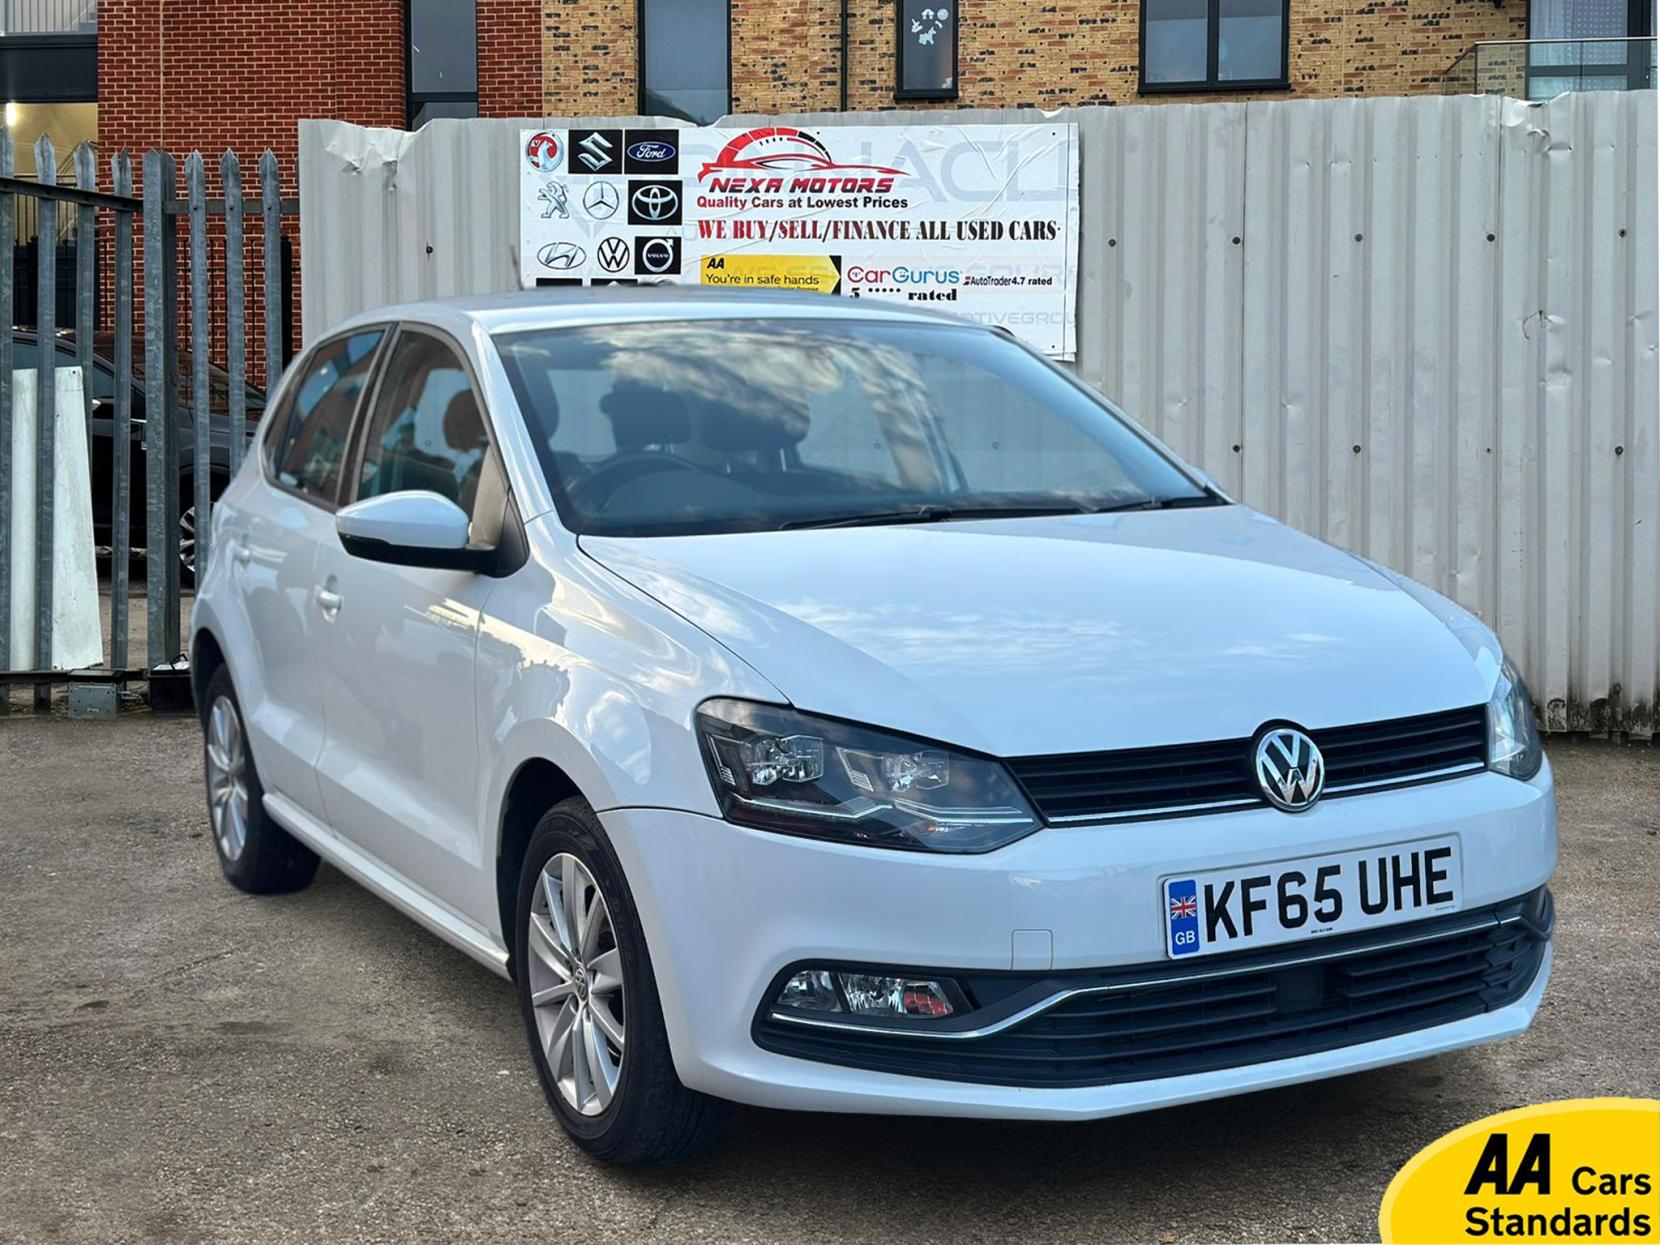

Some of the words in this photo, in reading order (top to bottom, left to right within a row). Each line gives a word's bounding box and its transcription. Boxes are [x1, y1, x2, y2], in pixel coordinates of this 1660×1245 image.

[637, 144, 666, 158] Ford
[709, 178, 783, 193] NEXA
[789, 178, 894, 193] MOTORS
[697, 196, 747, 210] Quality
[752, 196, 784, 208] Cars
[788, 197, 801, 208] at
[807, 196, 858, 208] Lowest
[863, 196, 908, 208] Prices
[697, 220, 727, 240] WE
[916, 220, 951, 240] ALL
[956, 220, 1003, 240] USED
[1009, 220, 1057, 240] CARS
[706, 257, 725, 269] AA
[706, 273, 741, 284] You're
[744, 273, 755, 284] in
[757, 273, 781, 285] safe
[783, 274, 820, 286] hands
[847, 266, 960, 284] CarGurus
[1028, 277, 1053, 286] rated
[908, 288, 957, 301] rated
[1204, 864, 1343, 942] KF65
[1358, 847, 1454, 915] UHE
[1175, 930, 1196, 946] GB
